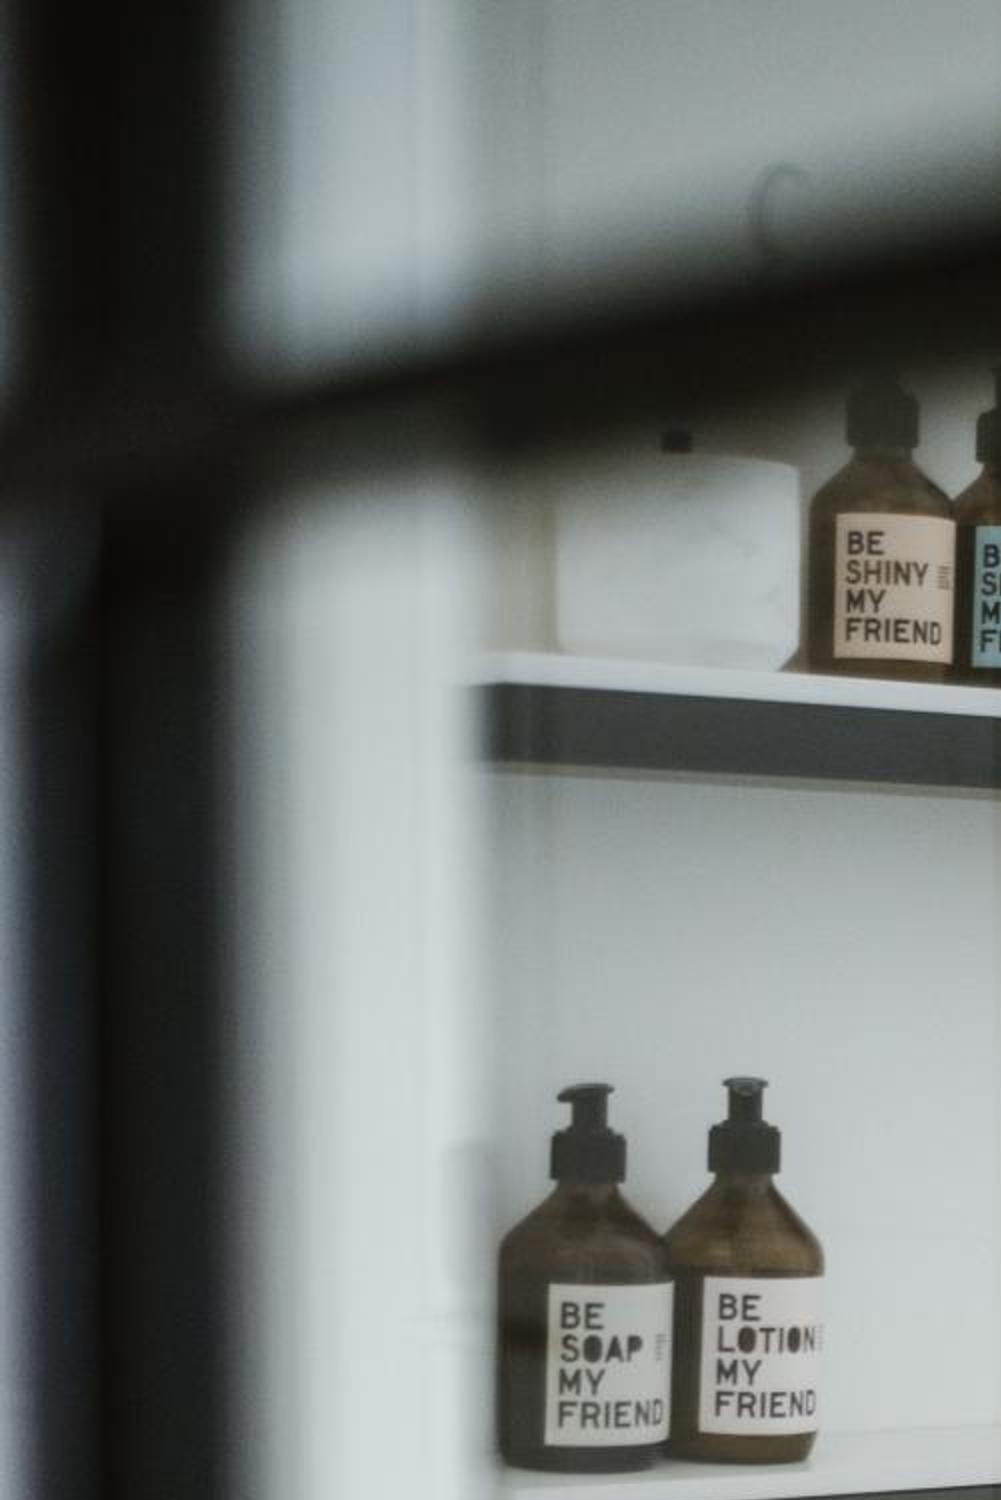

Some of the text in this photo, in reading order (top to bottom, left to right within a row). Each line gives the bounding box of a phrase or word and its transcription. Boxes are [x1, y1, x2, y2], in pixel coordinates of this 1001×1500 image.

[847, 531, 886, 556] BE
[846, 560, 928, 586] SHINY
[846, 589, 886, 613] MY
[845, 618, 942, 645] FRIEND
[560, 1301, 605, 1331] BE
[719, 1293, 762, 1321] BE
[560, 1334, 643, 1363] SOAP
[718, 1326, 816, 1354] LOTION
[559, 1368, 606, 1396] MY
[716, 1358, 762, 1386] MY
[557, 1398, 664, 1429] FRIEND
[714, 1389, 816, 1419] FRIEND
